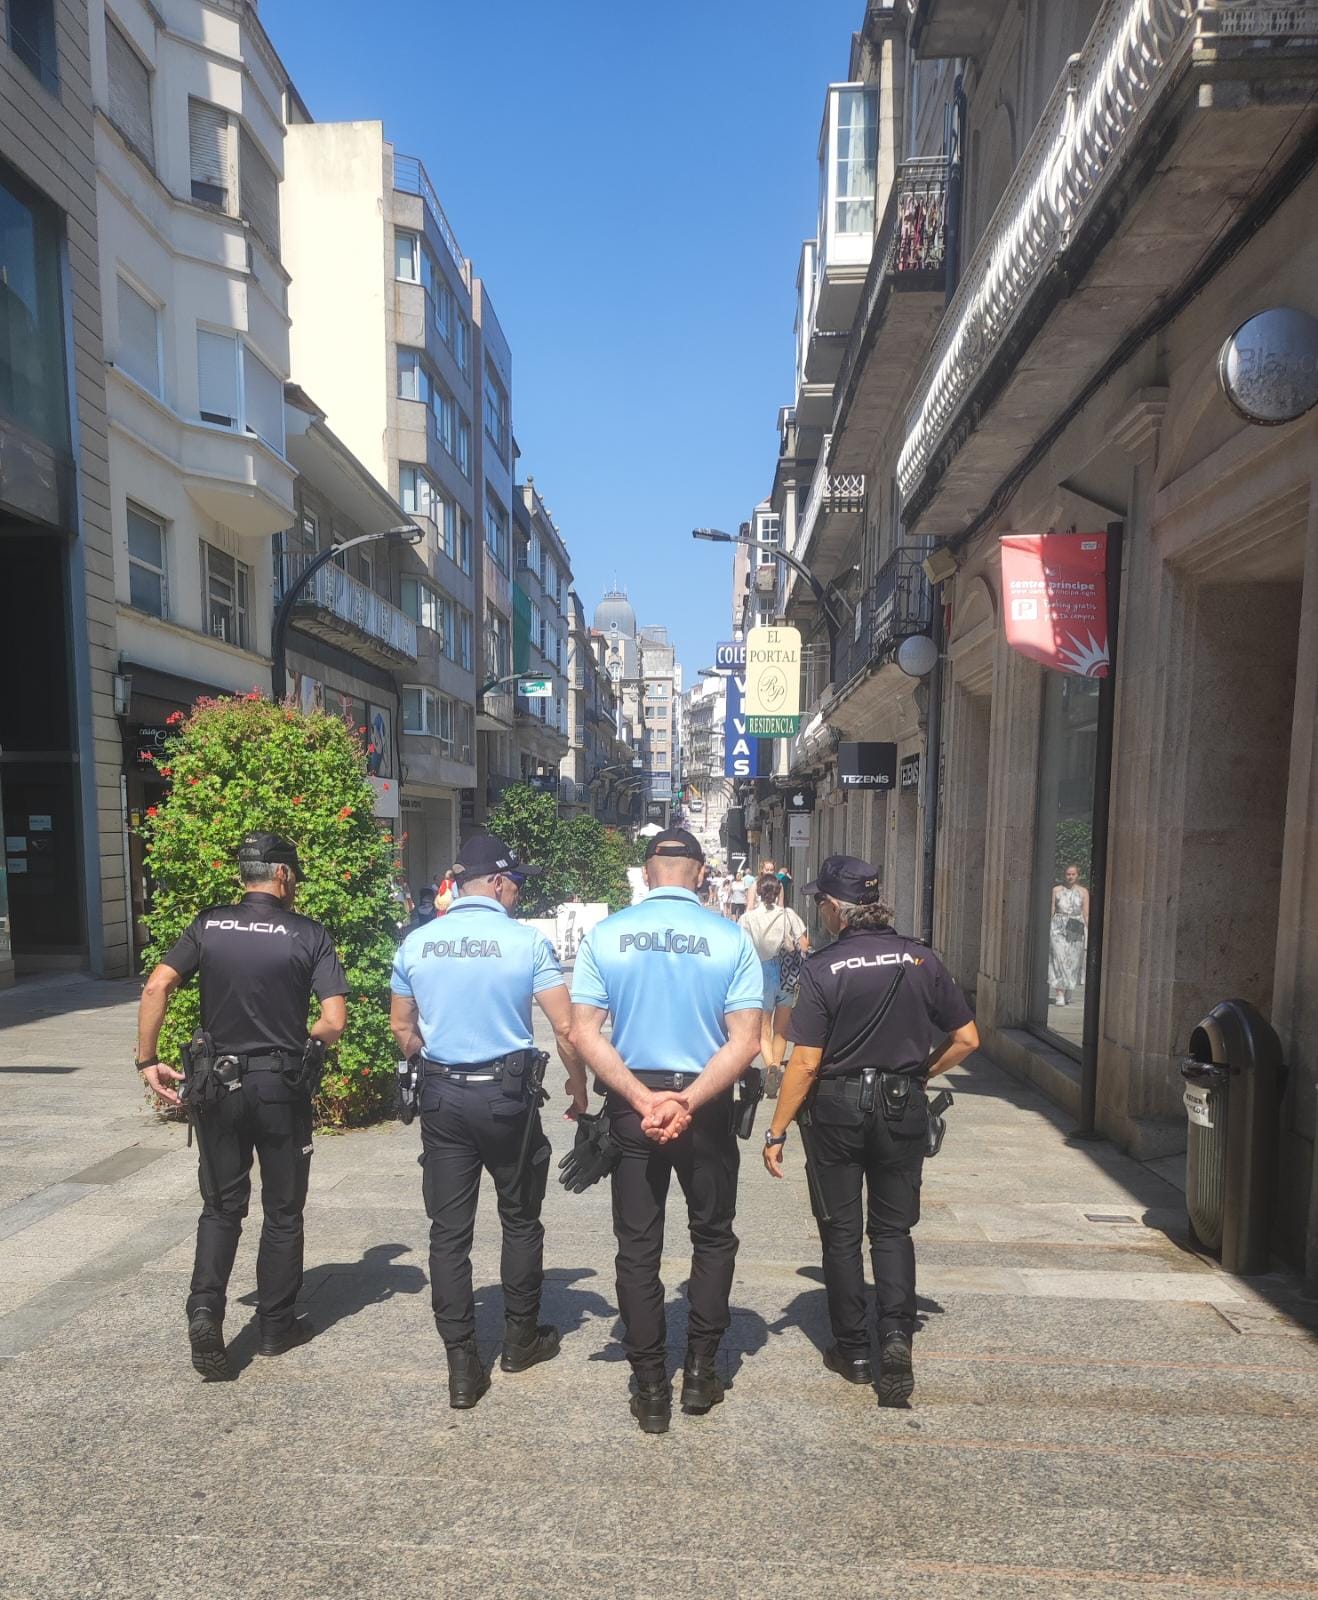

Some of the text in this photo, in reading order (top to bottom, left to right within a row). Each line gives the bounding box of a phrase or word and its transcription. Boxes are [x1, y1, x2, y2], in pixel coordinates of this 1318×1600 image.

[1010, 580, 1095, 592] centro principe
[767, 630, 781, 644] EL
[750, 650, 798, 663] PORTAL
[749, 717, 795, 733] RESIDENCIA
[205, 919, 287, 934] POLICIA
[421, 936, 502, 958] POLÍCIA
[619, 928, 711, 957] POLÍCIA
[830, 952, 914, 975] POLICIA
